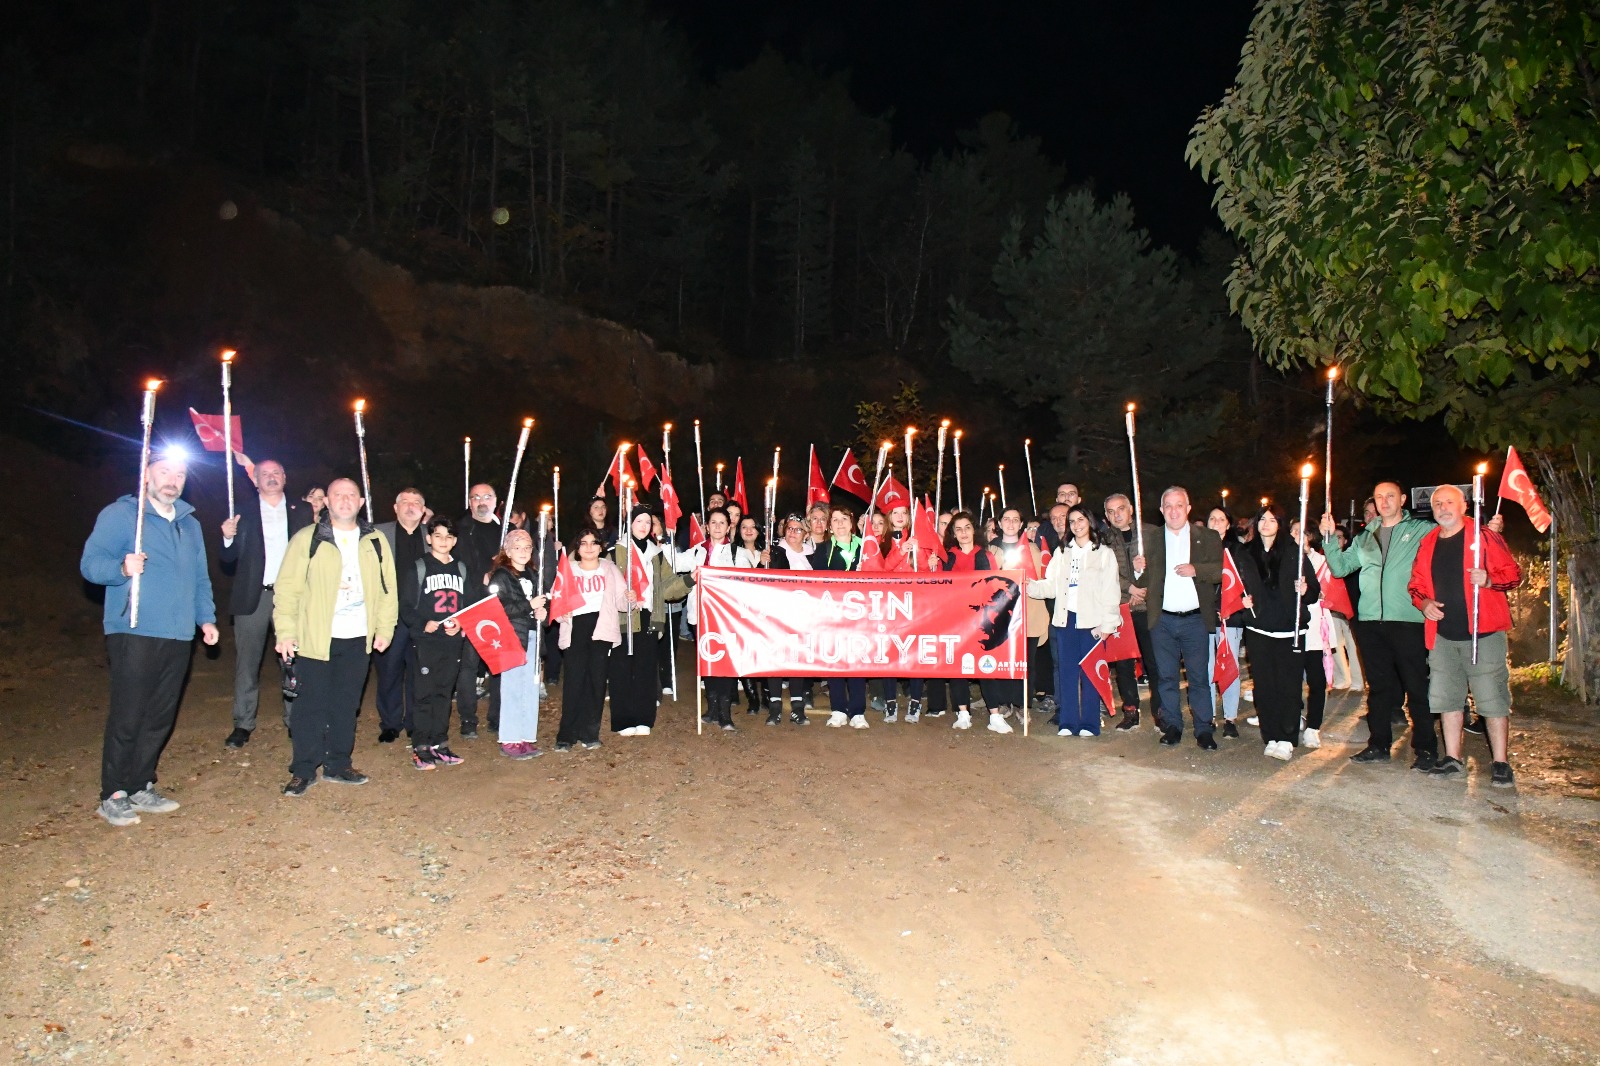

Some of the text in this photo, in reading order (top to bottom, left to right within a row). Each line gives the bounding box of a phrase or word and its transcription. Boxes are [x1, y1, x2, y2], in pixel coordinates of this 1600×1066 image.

[424, 573, 464, 595] JORDAN
[574, 574, 606, 593] NJOY
[434, 590, 458, 613] 23
